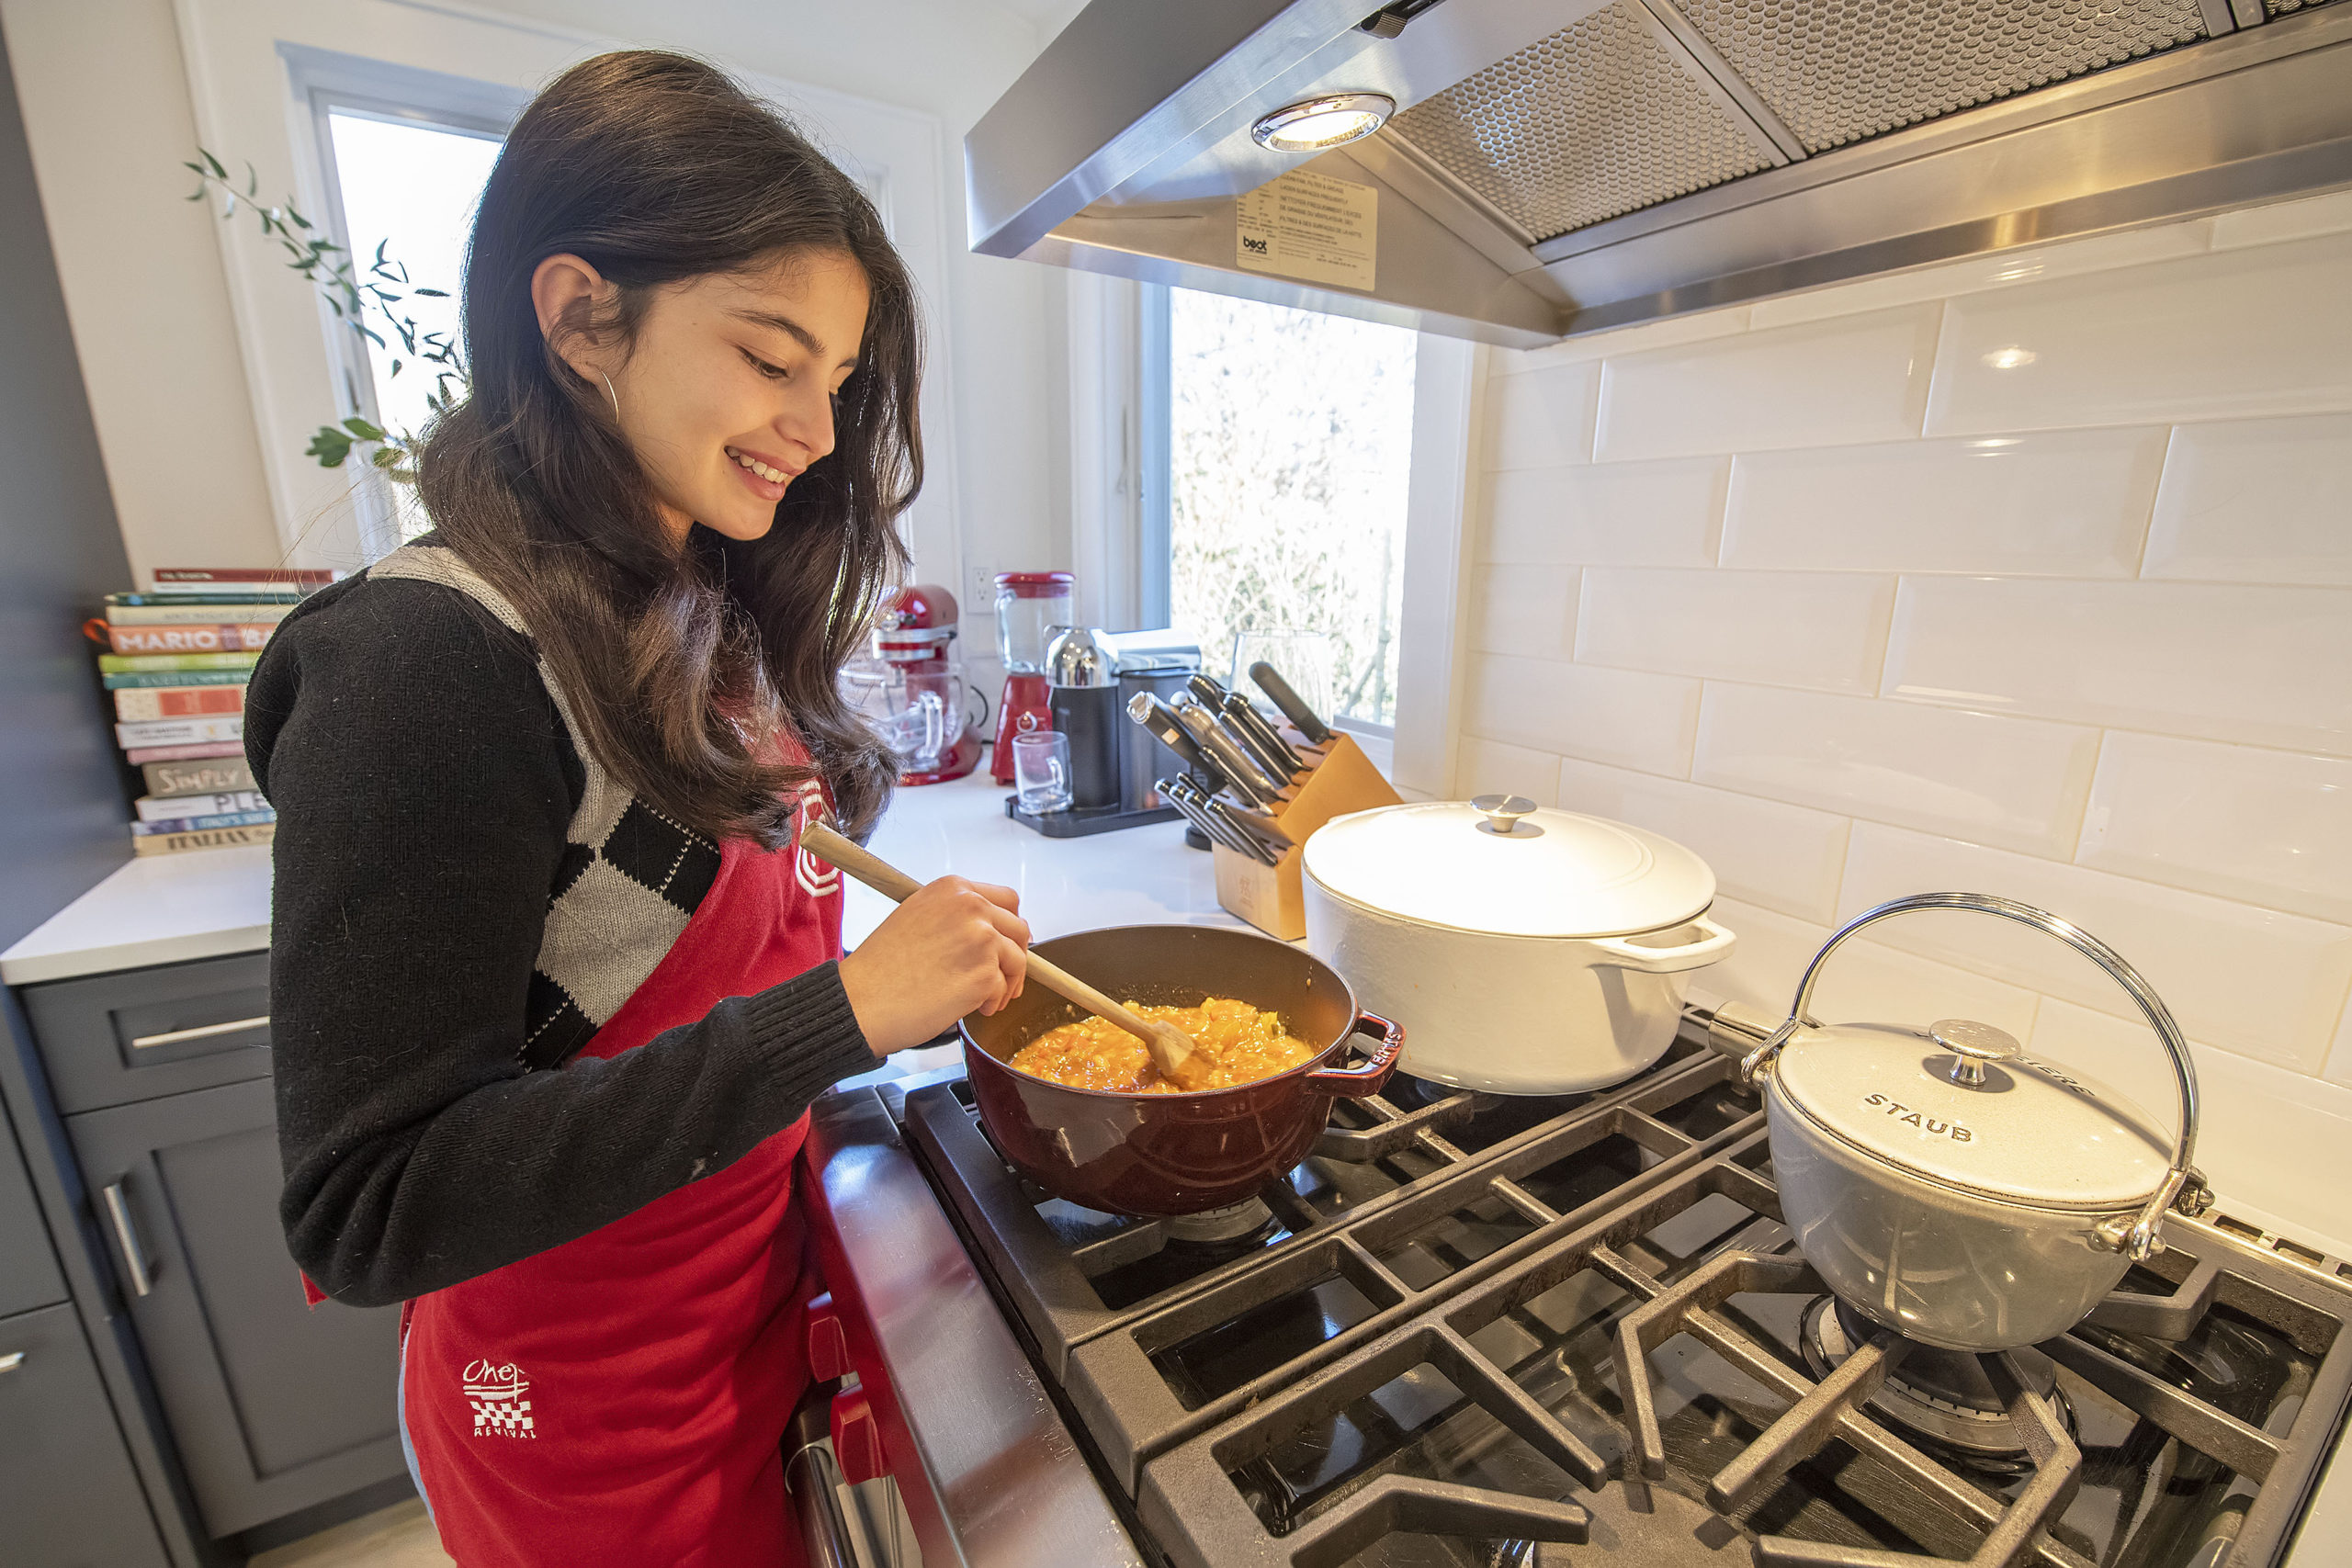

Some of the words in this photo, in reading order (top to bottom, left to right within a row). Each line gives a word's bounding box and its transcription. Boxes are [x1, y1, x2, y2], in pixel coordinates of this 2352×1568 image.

[117, 630, 218, 650] MARIO
[1864, 1093, 1972, 1142] STAUB
[474, 1427, 537, 1439] REVIVAL
